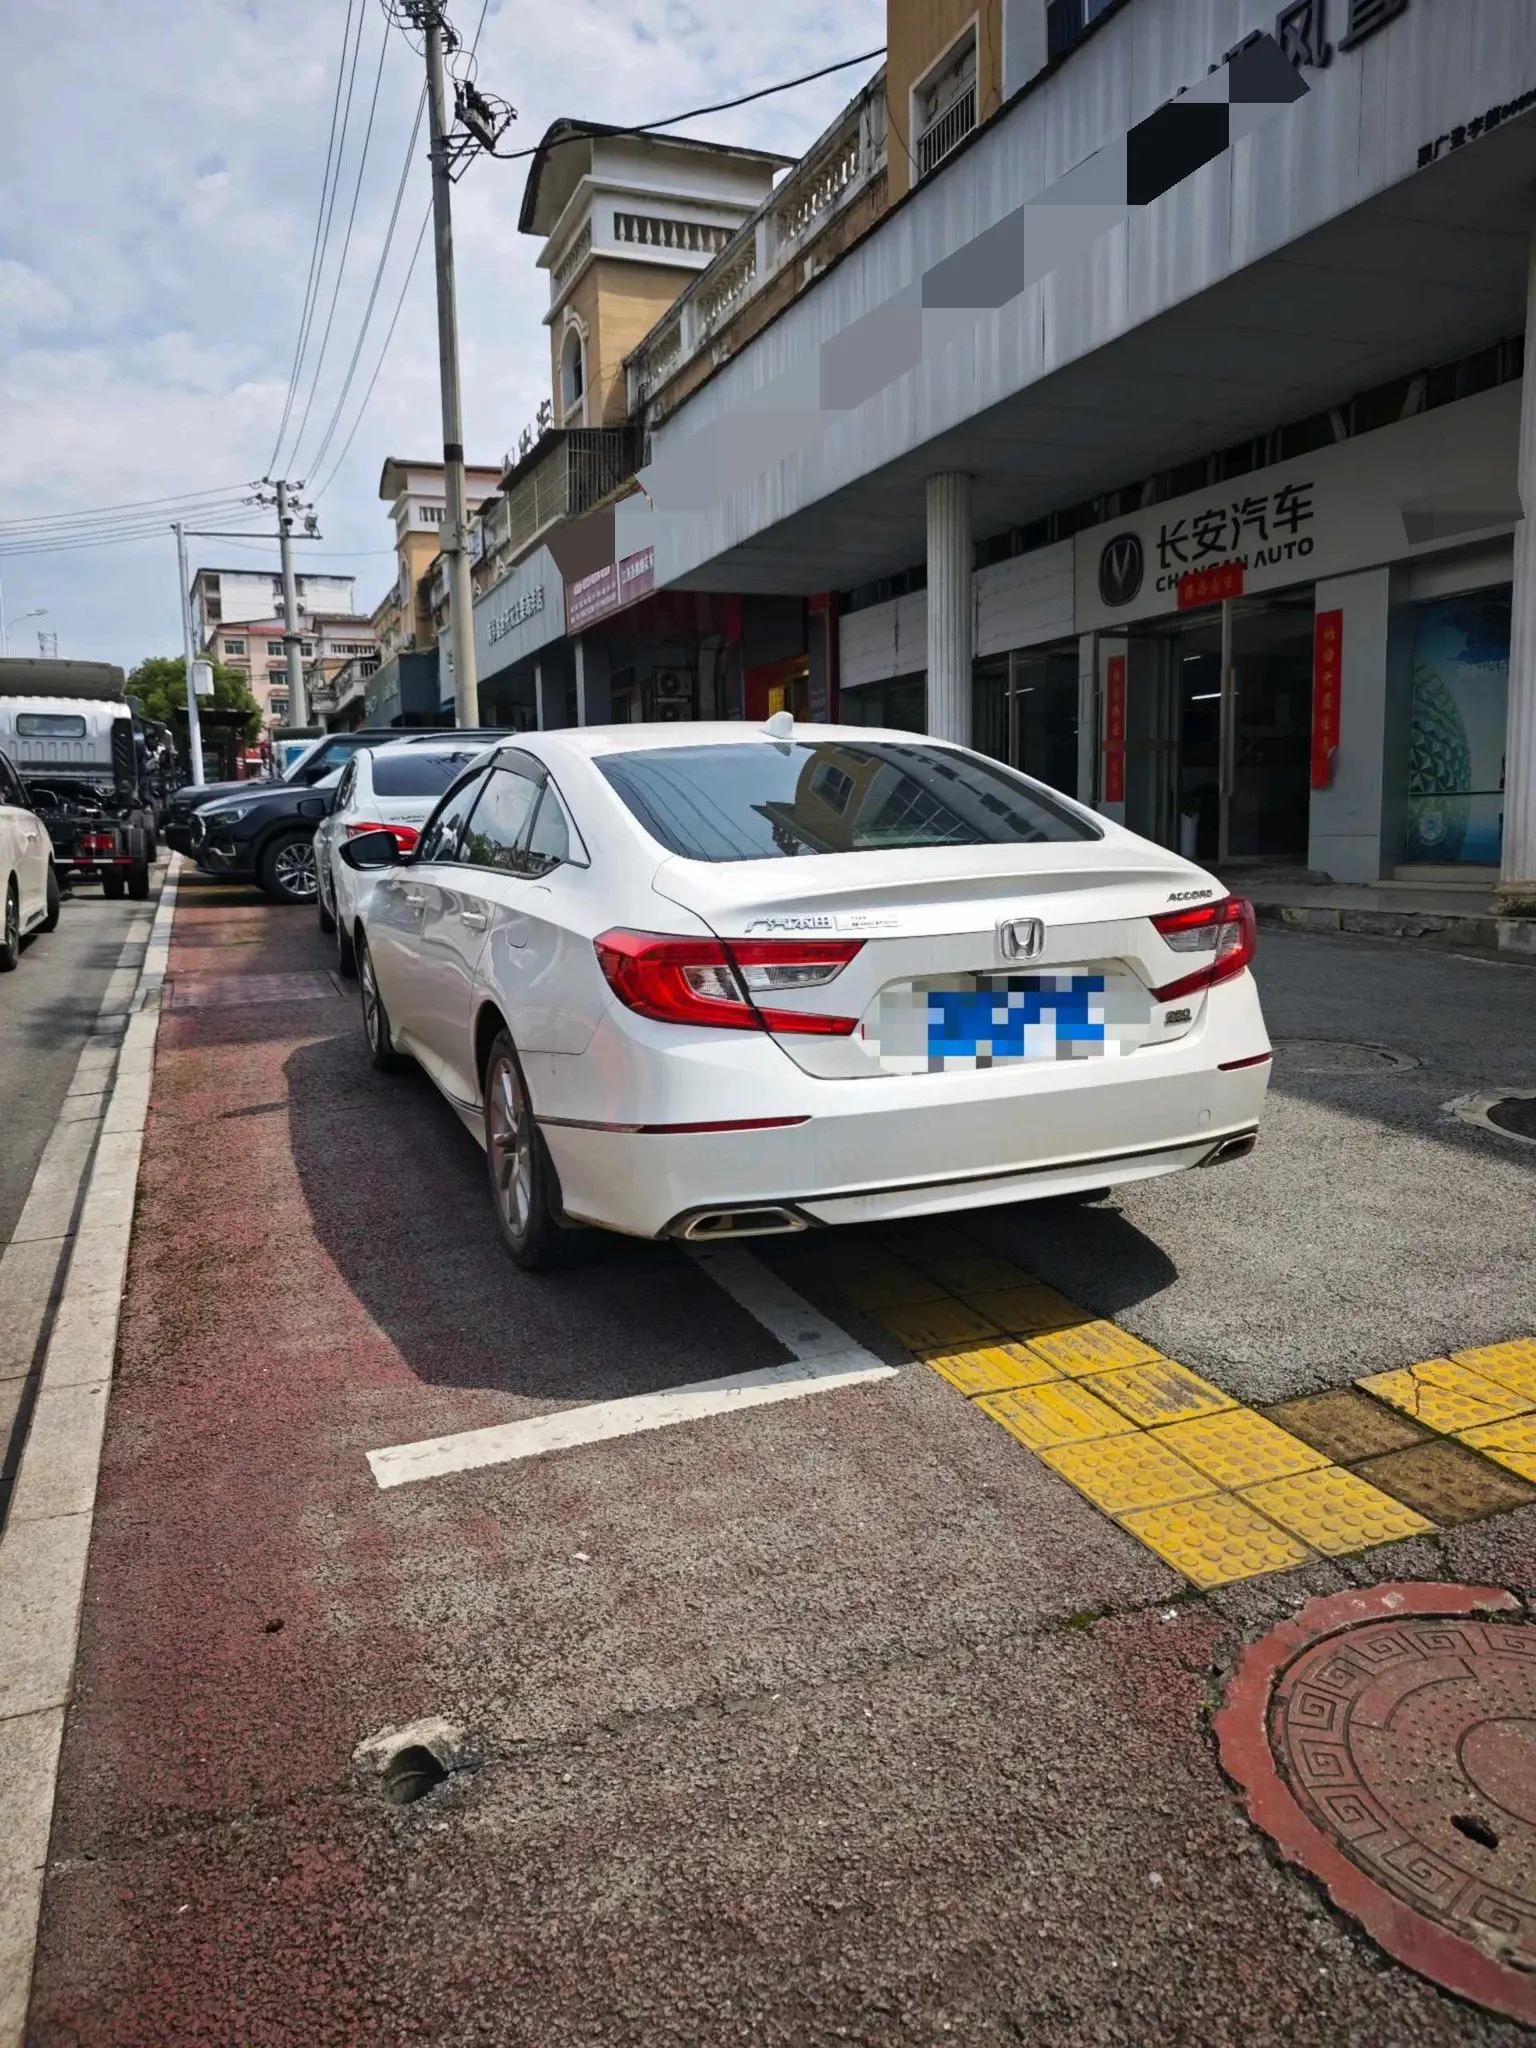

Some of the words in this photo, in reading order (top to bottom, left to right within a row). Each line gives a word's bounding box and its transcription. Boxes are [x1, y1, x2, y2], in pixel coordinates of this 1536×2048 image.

[1156, 482, 1314, 569] 长安汽车
[1254, 537, 1315, 569] AUTO
[1167, 889, 1214, 903] ACCORD
